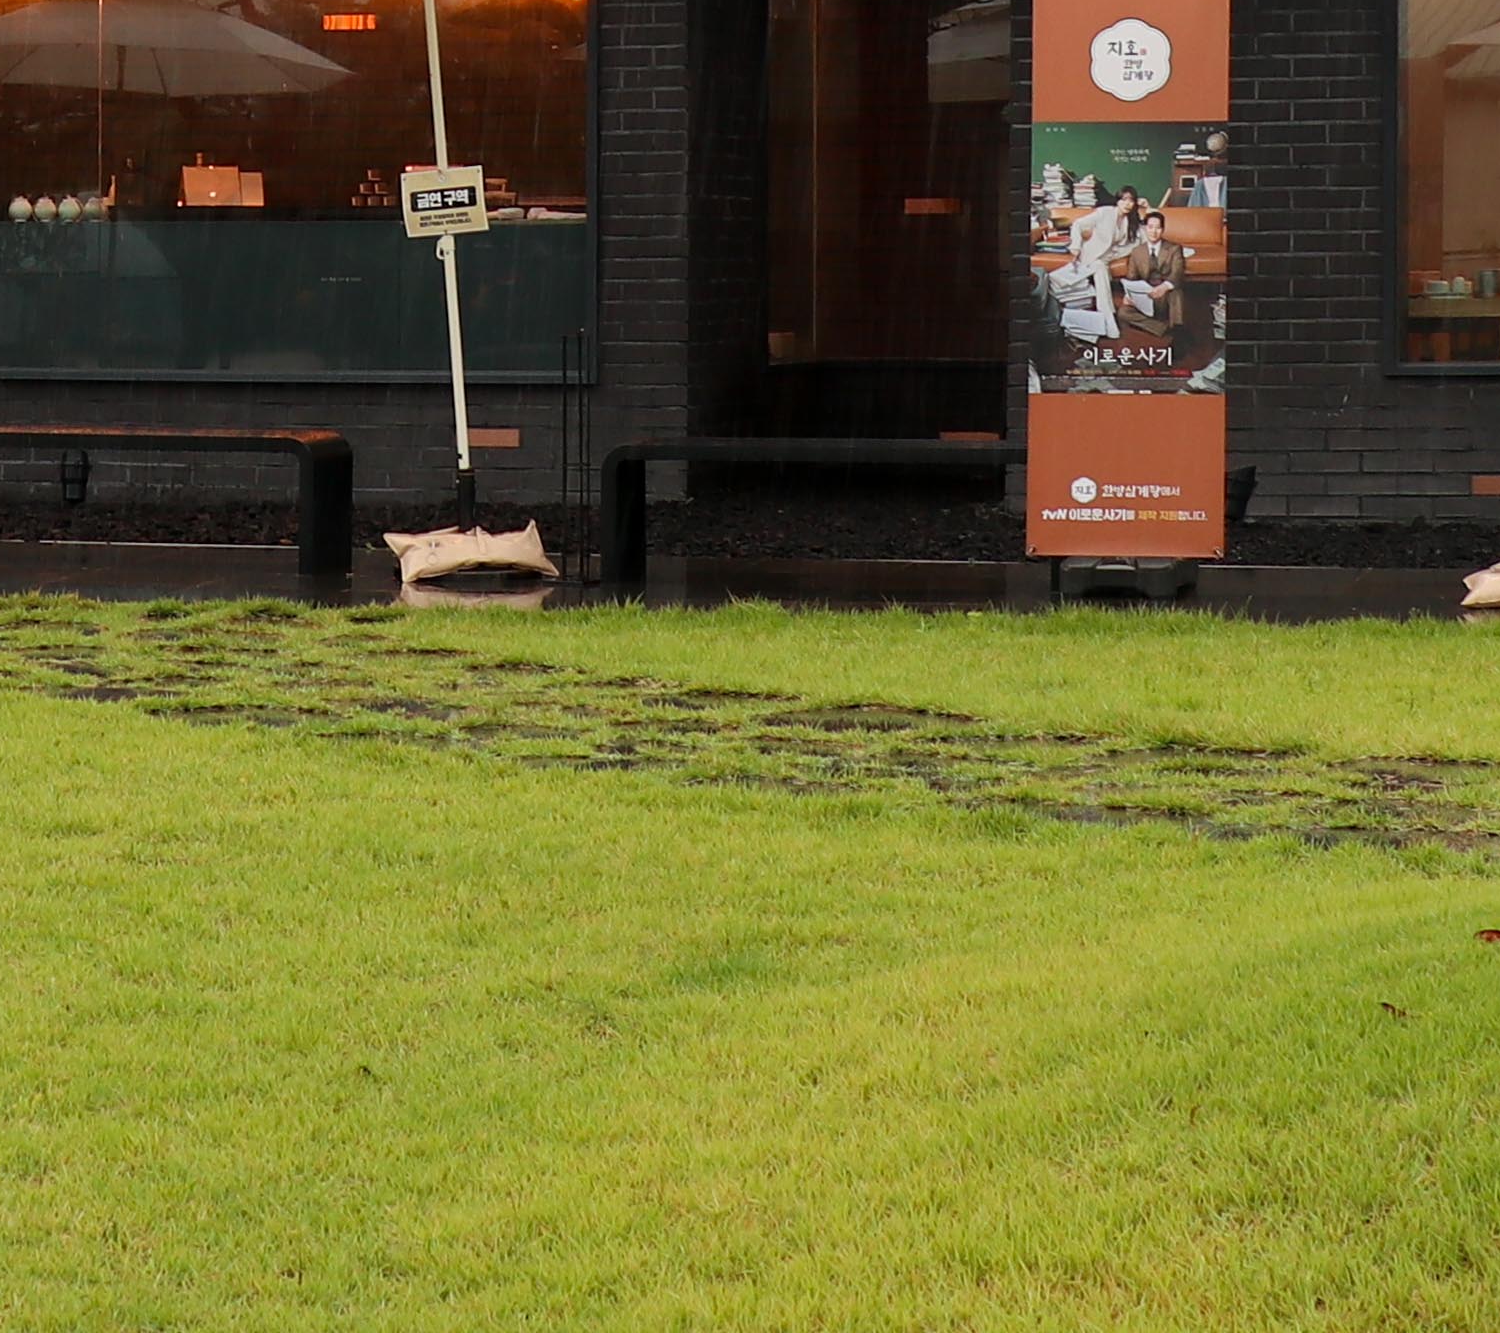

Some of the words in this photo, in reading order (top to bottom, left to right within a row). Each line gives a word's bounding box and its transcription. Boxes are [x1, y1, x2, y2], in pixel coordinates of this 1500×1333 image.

[1107, 40, 1139, 56] 지호
[416, 192, 442, 209] 금연
[443, 189, 470, 205] 구역
[1083, 347, 1173, 366] 이로운사기
[1041, 508, 1067, 520] tvN
[1068, 508, 1135, 521] 이로운사기를
